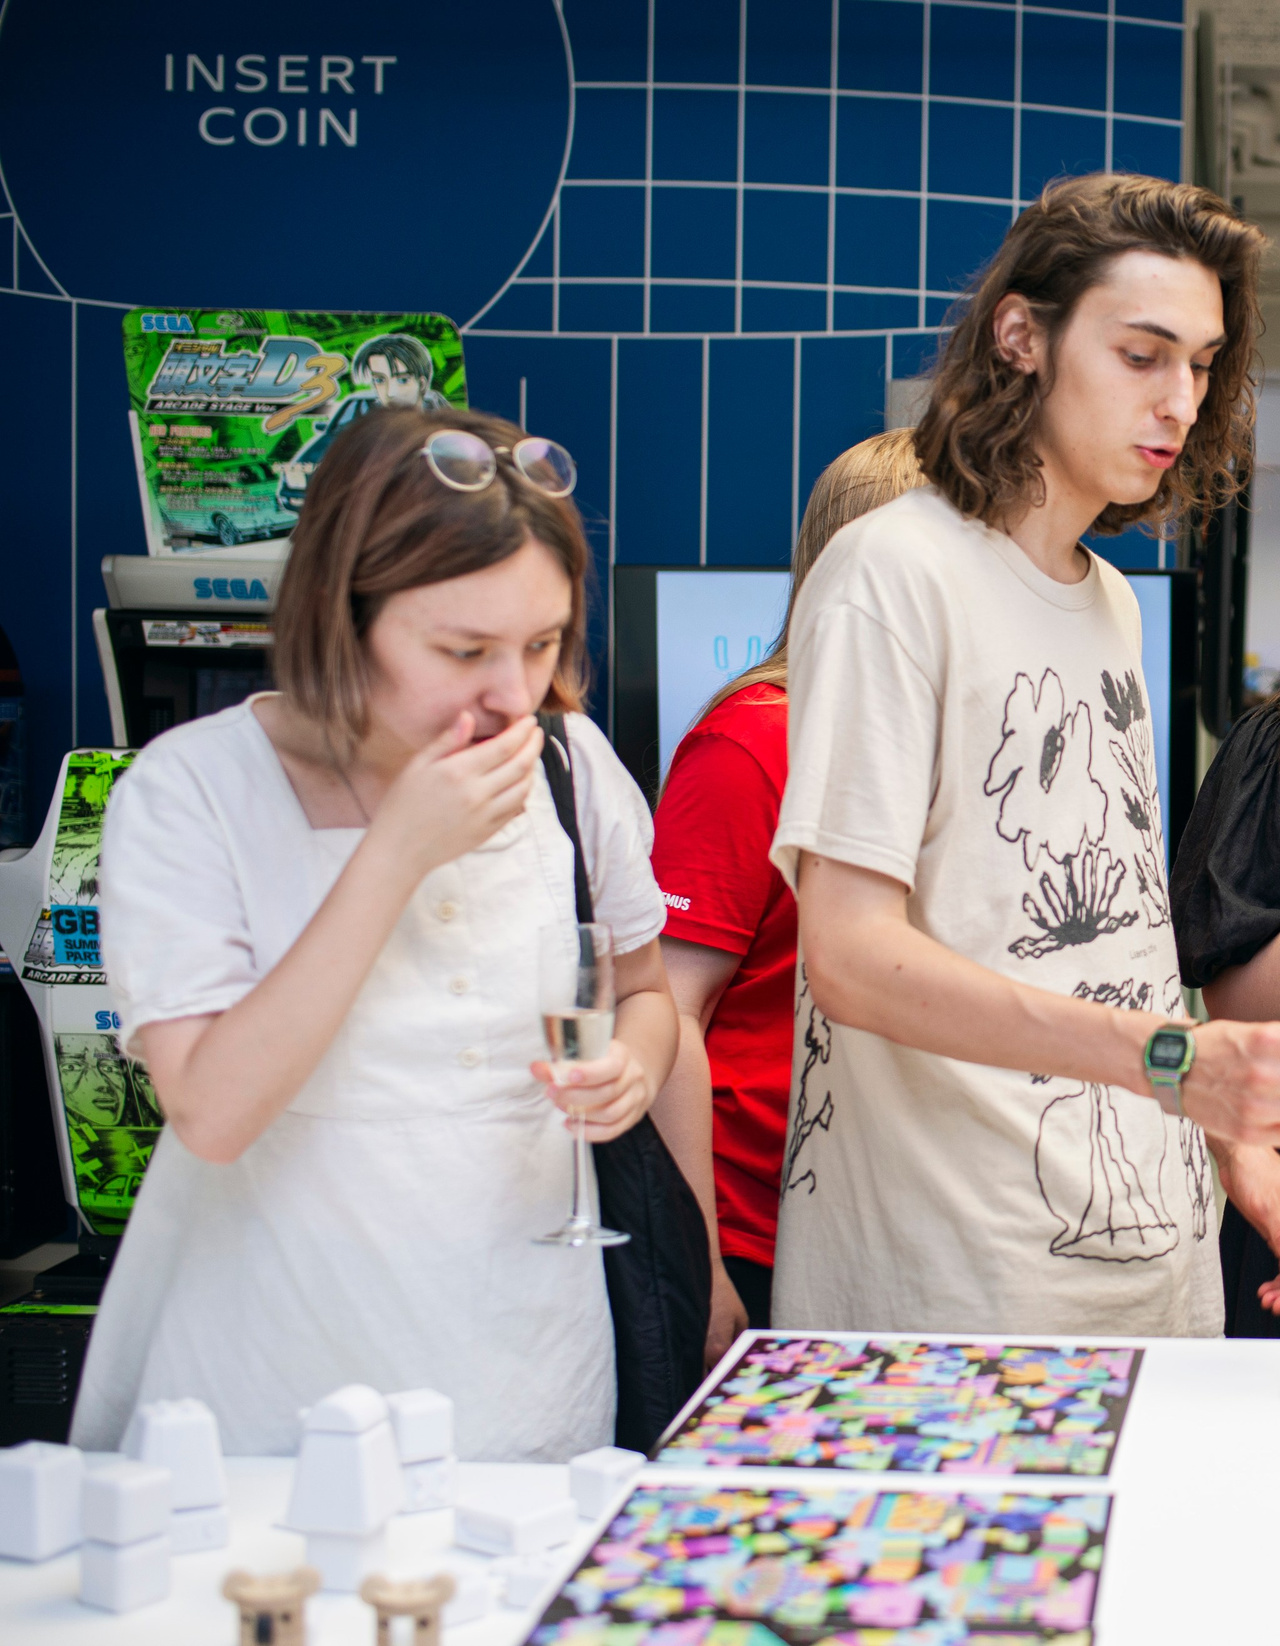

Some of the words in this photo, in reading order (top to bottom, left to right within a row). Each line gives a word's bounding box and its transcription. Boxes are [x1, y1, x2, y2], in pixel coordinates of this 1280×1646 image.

[165, 54, 397, 94] INSERT
[198, 107, 357, 146] COIN
[141, 314, 194, 333] SEGA
[154, 401, 207, 410] ARCADE
[209, 402, 251, 411] STAGE
[193, 577, 269, 600] SEGA
[66, 951, 101, 962] PART
[26, 969, 75, 983] ARCADE
[79, 973, 107, 984] STA
